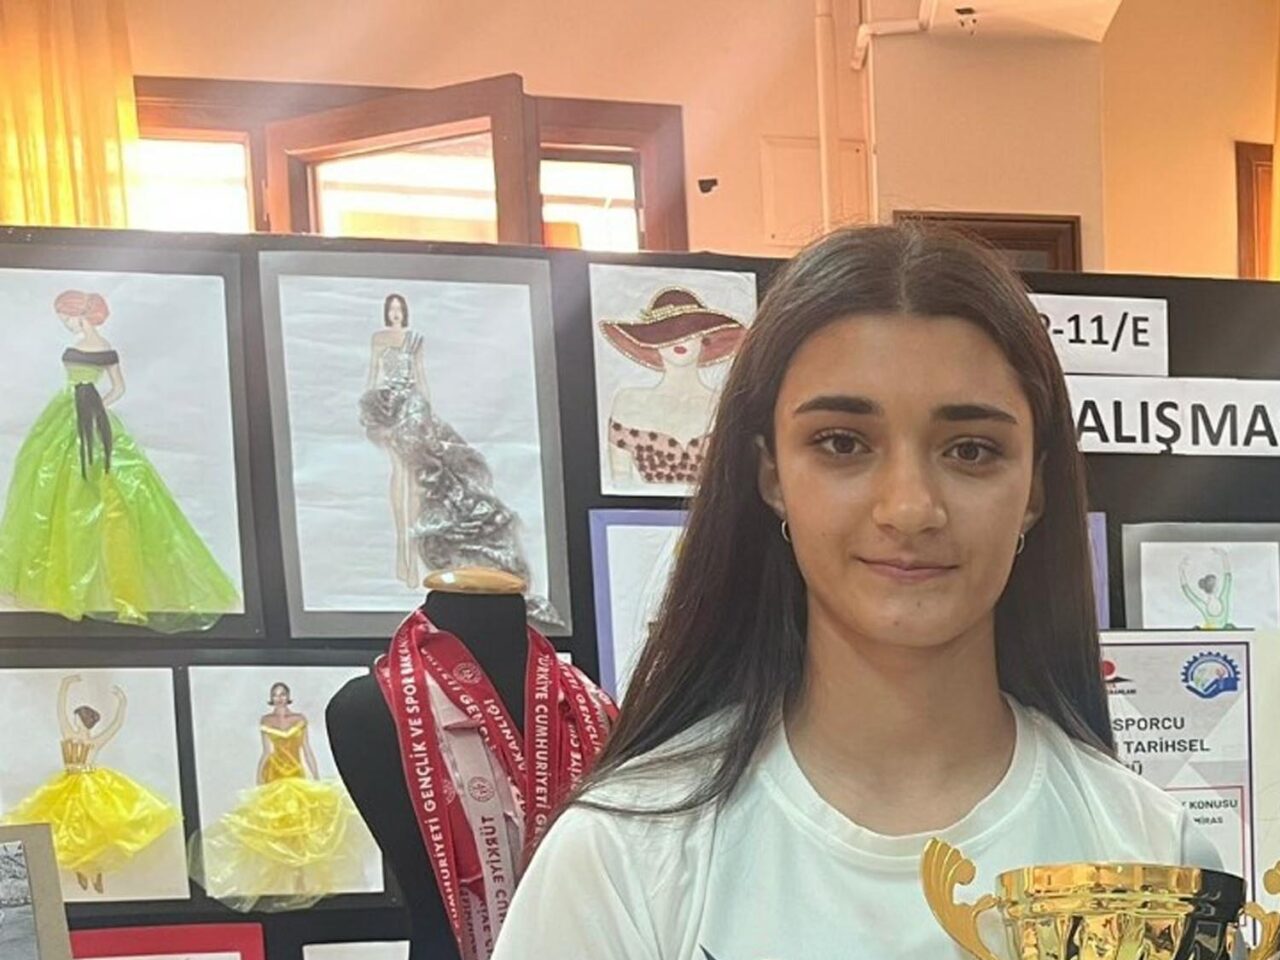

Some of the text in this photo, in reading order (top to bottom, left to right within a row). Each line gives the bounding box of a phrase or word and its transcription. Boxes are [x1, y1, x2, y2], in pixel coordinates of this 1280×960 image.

[1039, 311, 1150, 352] -11/E
[408, 718, 425, 738] VE
[483, 698, 527, 772] AKANLIĞI
[1112, 716, 1185, 732] SPORCU
[534, 704, 552, 808] CUMHURİYETİ
[1124, 737, 1211, 754] TARİHSEL
[409, 741, 437, 812] GENÇLİK
[1188, 799, 1238, 810] KONUSU
